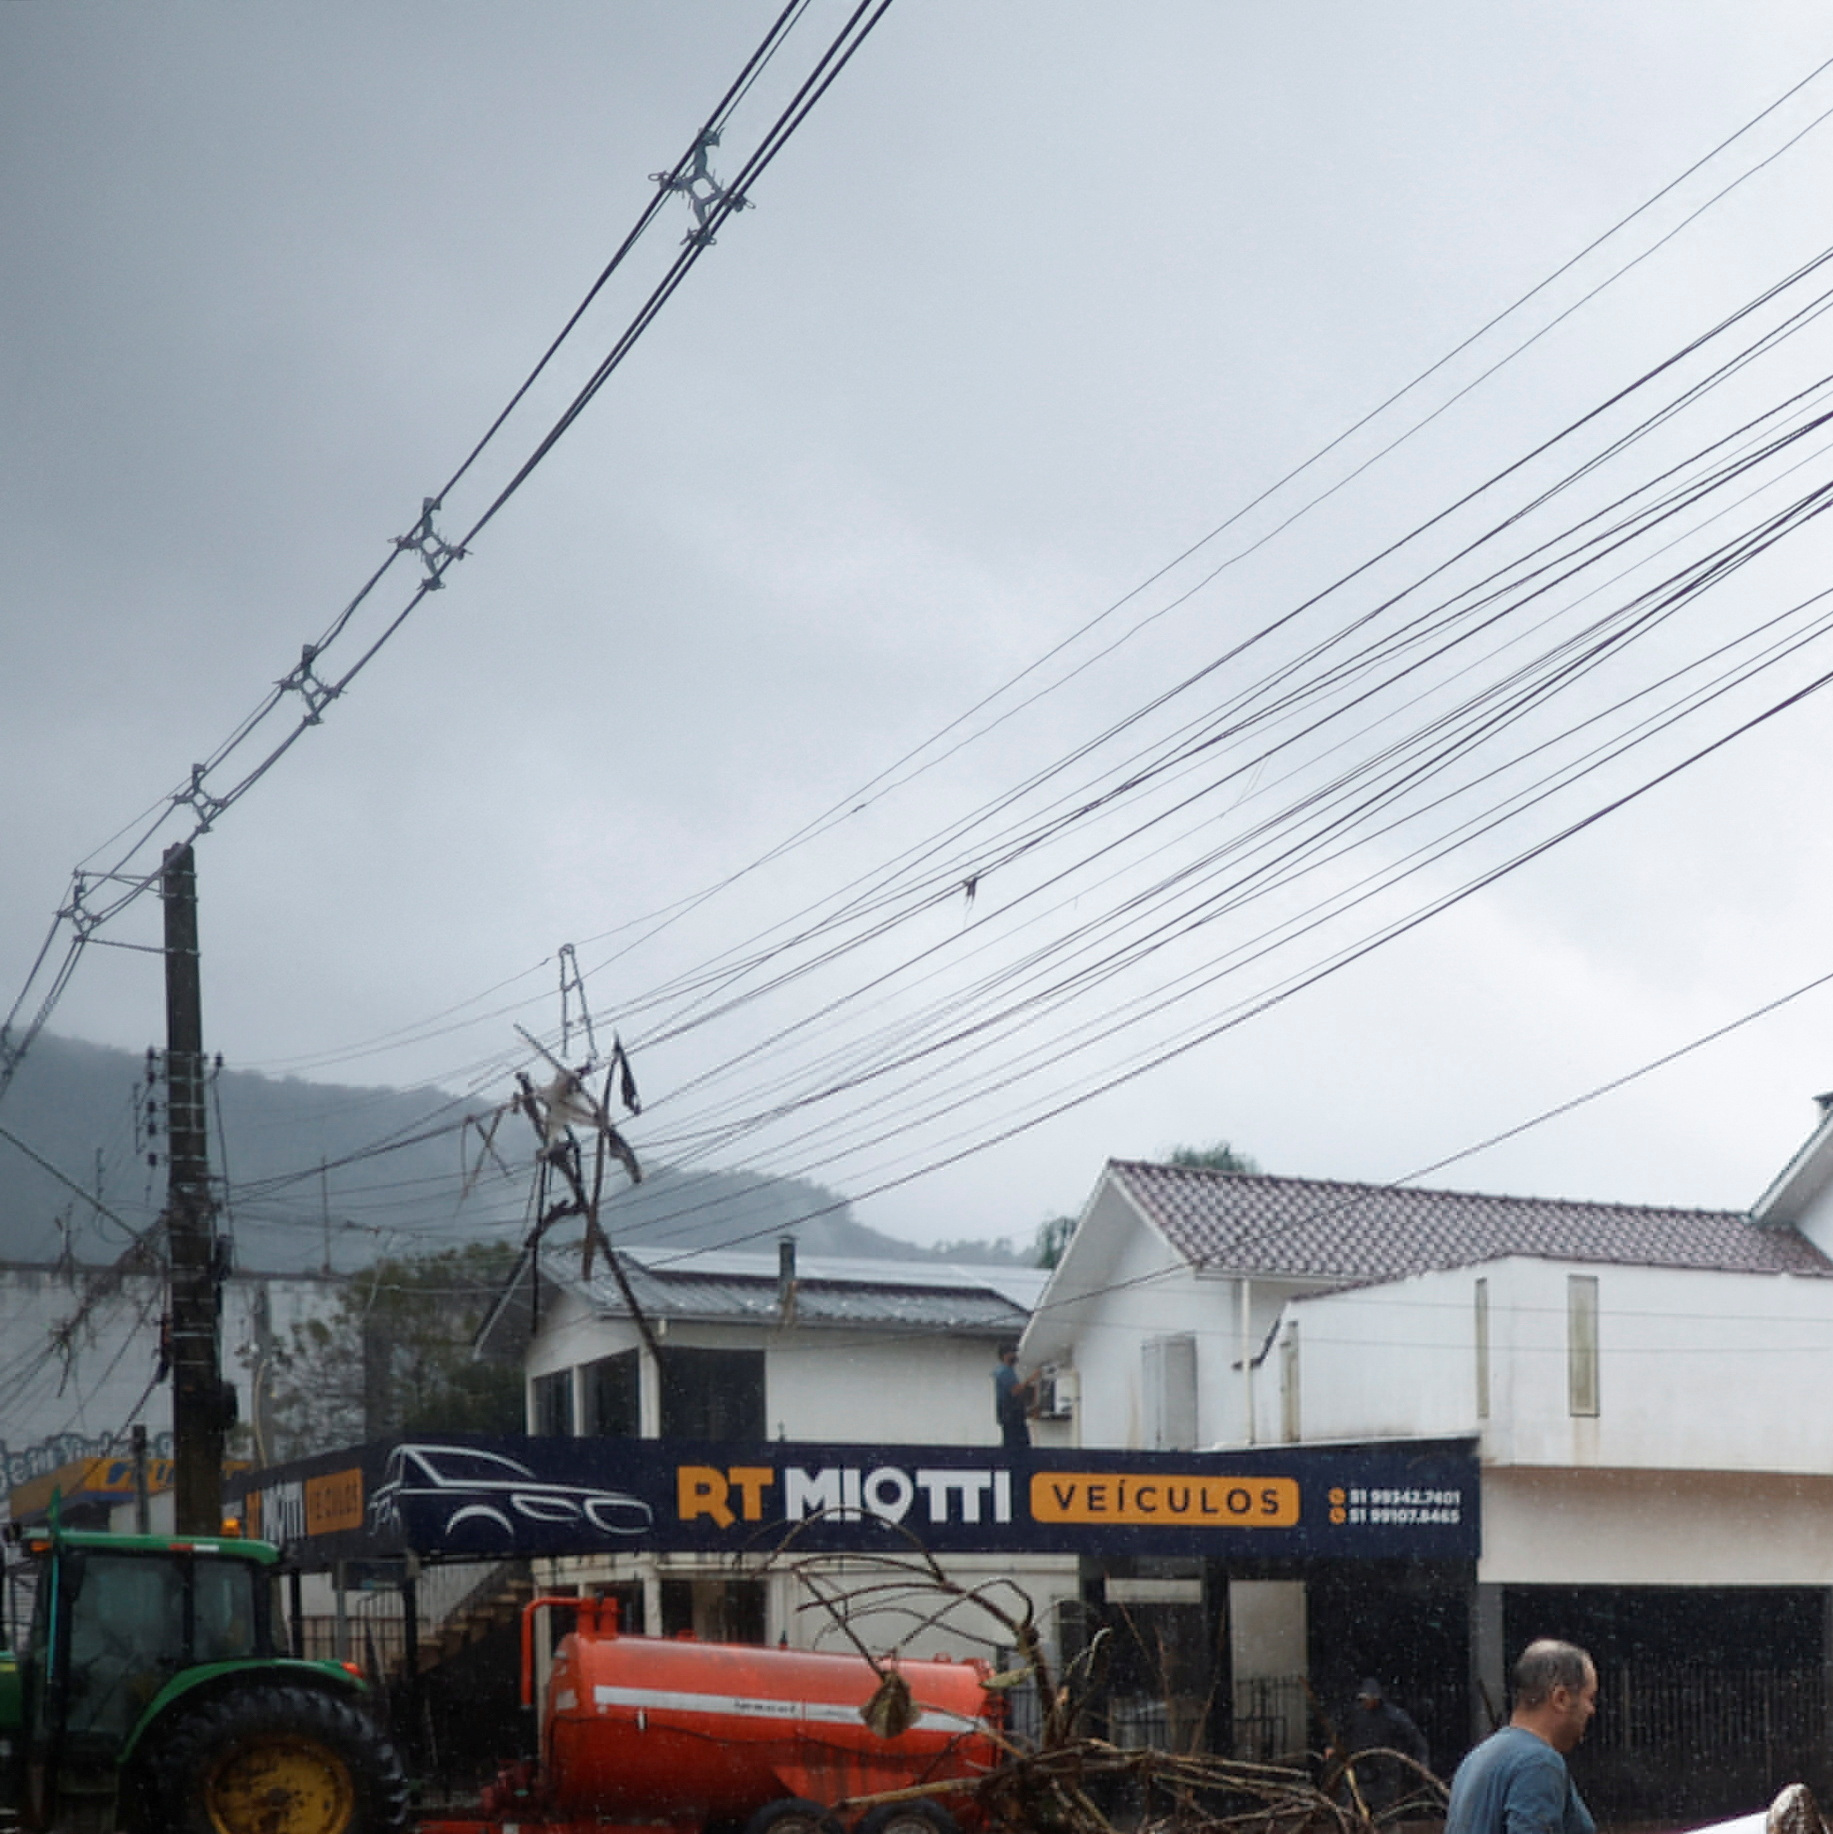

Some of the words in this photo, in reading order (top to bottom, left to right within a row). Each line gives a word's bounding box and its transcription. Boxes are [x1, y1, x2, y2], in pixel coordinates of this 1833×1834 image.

[677, 1466, 774, 1529] RT
[784, 1466, 1011, 1528] MIOTTI
[1053, 1479, 1279, 1514] VEÍCULOS
[1350, 1508, 1367, 1525] 51
